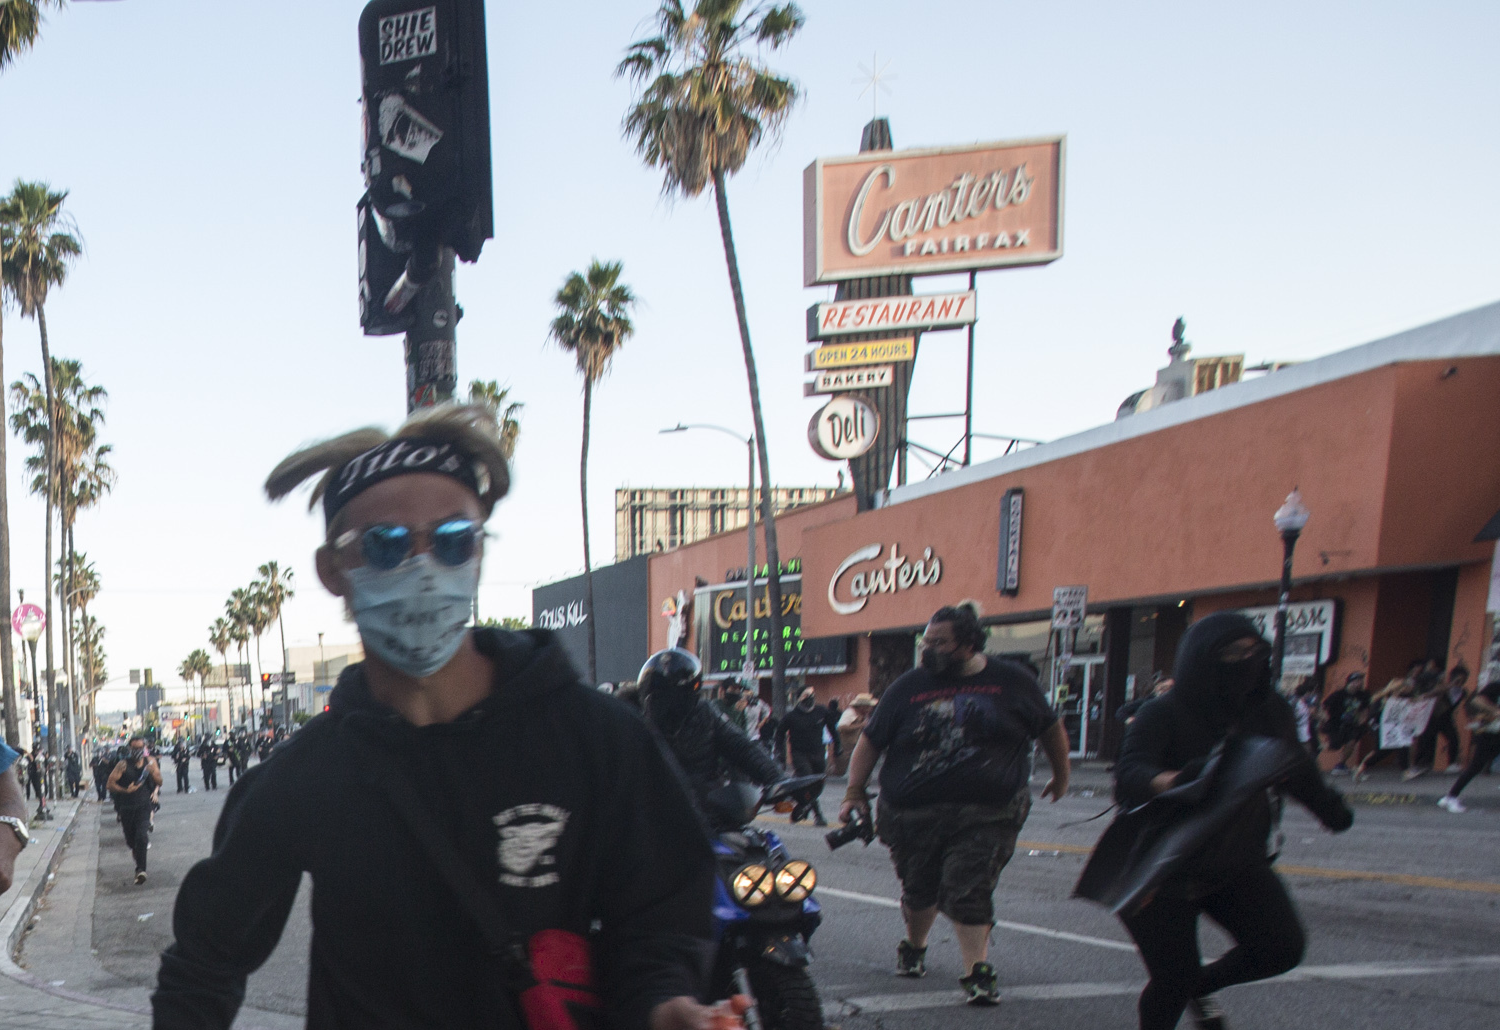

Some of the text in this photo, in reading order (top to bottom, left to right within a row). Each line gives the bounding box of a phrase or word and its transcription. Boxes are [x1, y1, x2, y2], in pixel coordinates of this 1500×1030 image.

[381, 32, 435, 61] DREW
[902, 228, 1031, 257] FAIRFAX
[821, 293, 973, 331] RESTAURANT
[818, 342, 908, 364] OPEN 24 HOURS
[821, 371, 888, 387] BAKERY
[826, 401, 868, 449] Deli
[827, 542, 942, 616] Canter's
[566, 598, 589, 629] KILL
